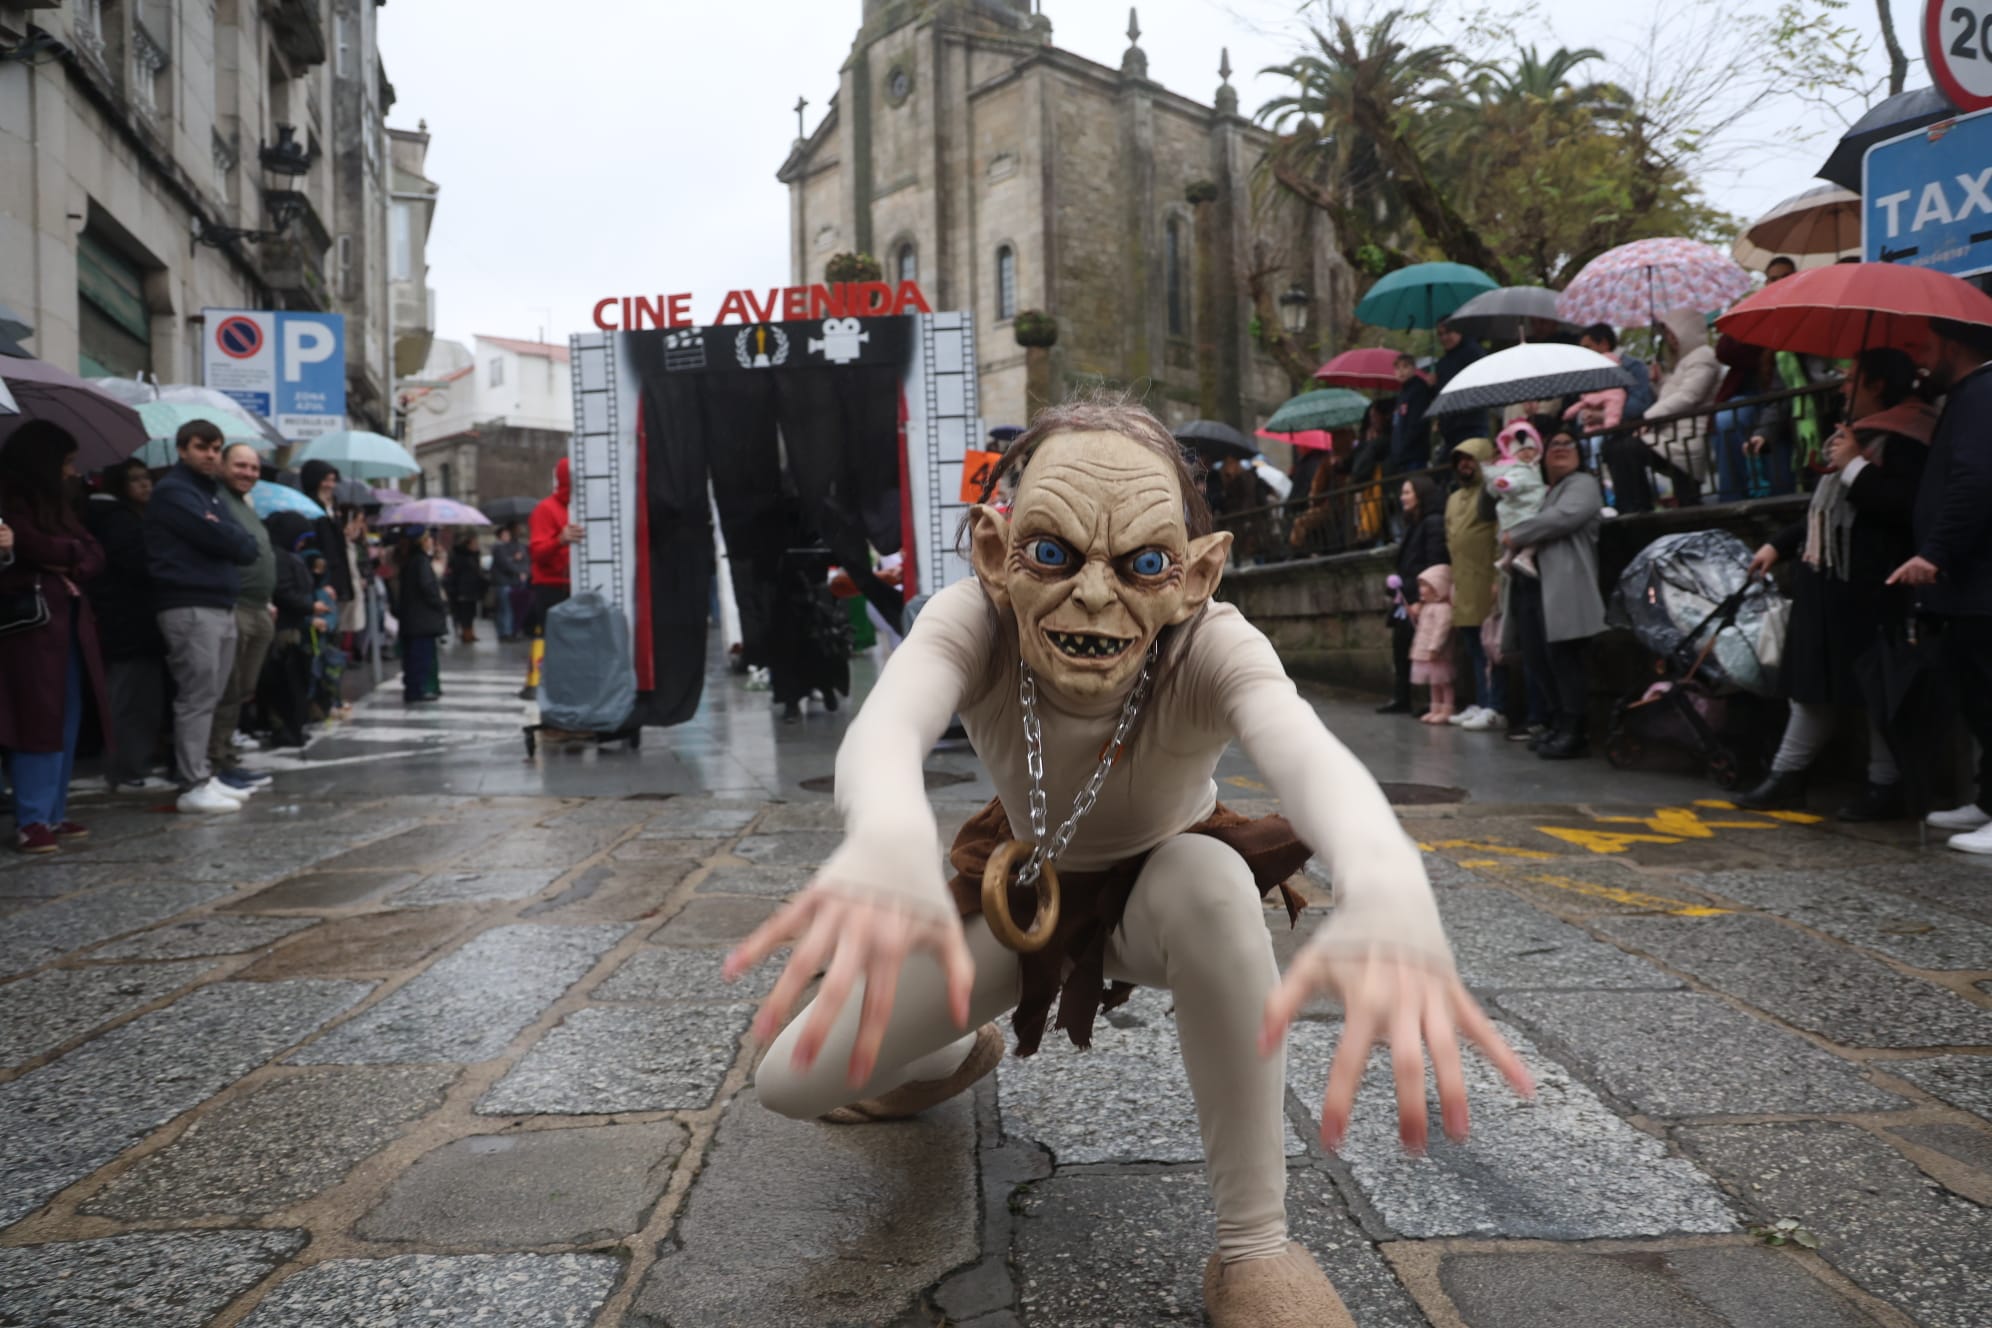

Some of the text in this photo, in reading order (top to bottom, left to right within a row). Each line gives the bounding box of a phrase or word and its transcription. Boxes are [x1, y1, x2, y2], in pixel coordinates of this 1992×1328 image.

[594, 280, 932, 330] CINE AVENIDA
[285, 321, 335, 381] P
